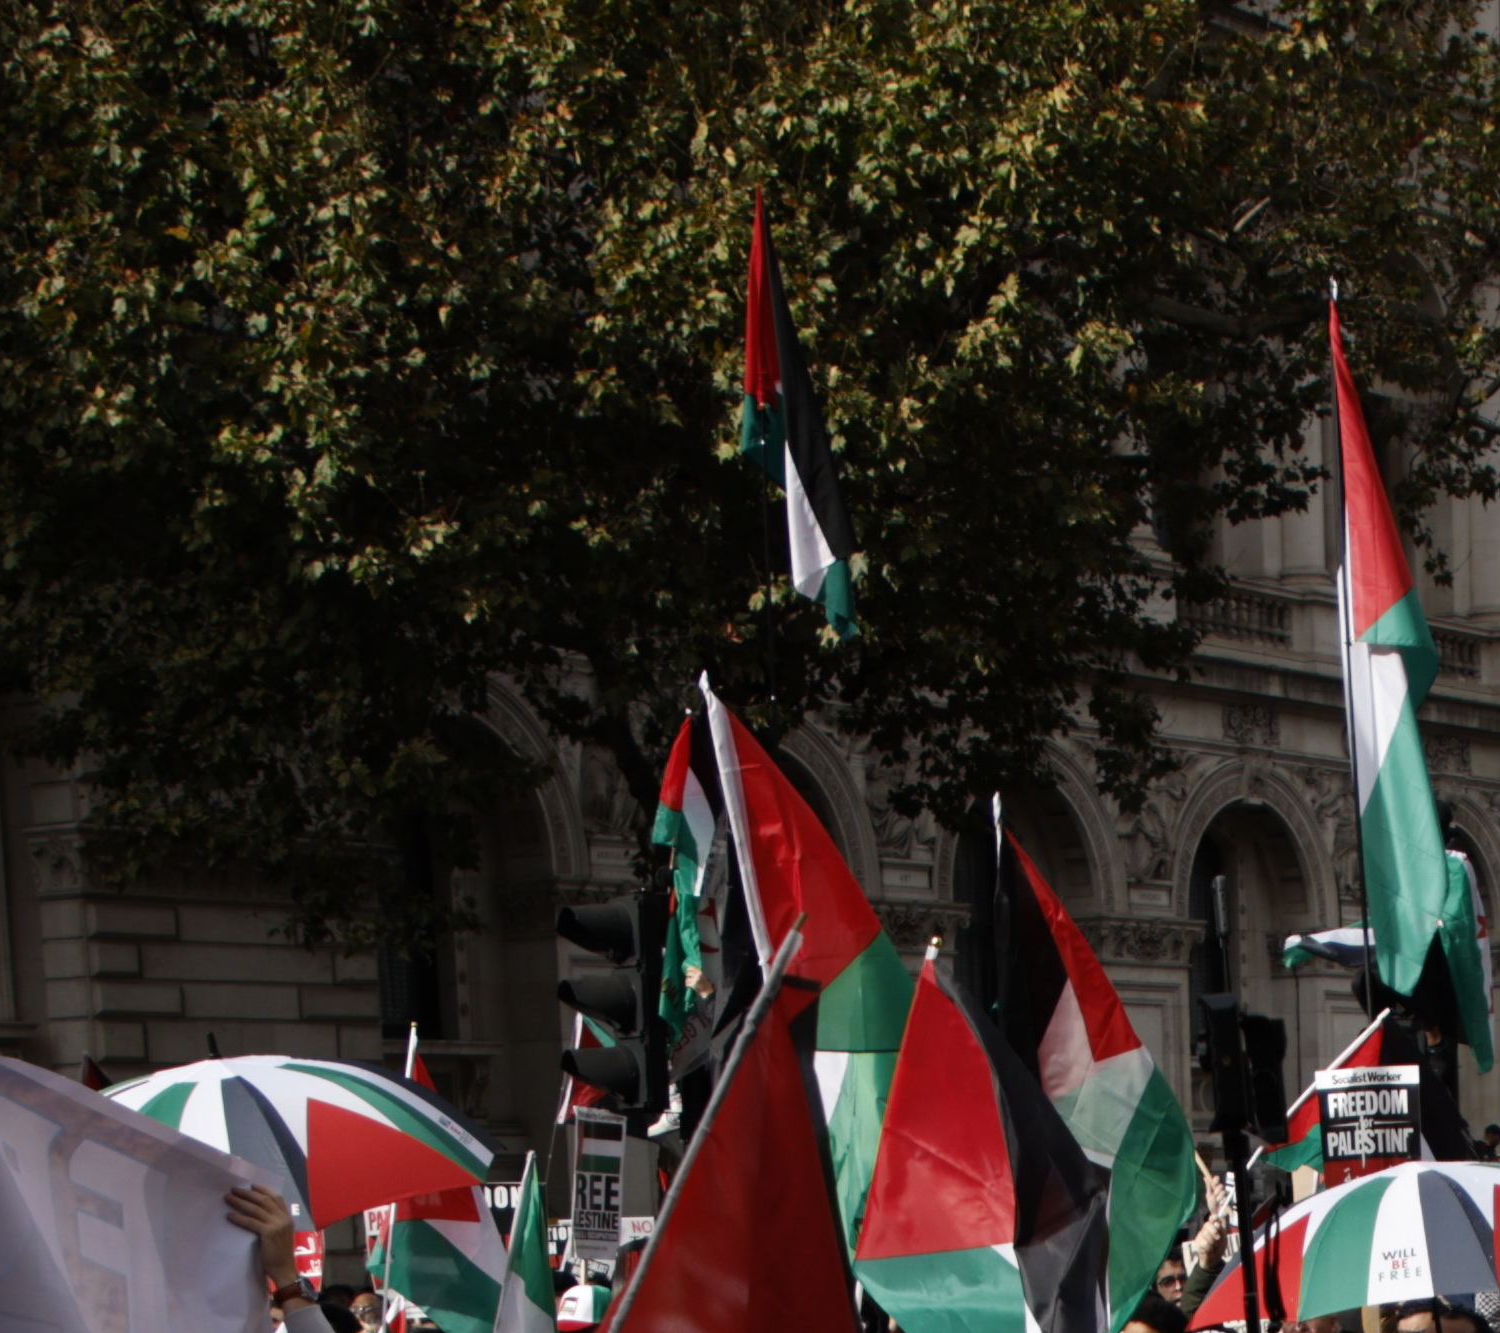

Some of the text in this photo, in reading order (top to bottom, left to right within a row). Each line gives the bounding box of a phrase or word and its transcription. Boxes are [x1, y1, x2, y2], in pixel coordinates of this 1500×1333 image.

[1368, 1071, 1402, 1083] Worker
[1327, 1088, 1409, 1119] FREEDOM
[631, 1220, 653, 1234] NO
[1381, 1247, 1417, 1261] WILL
[1392, 1258, 1408, 1270] BE
[1378, 1266, 1423, 1283] FREE
